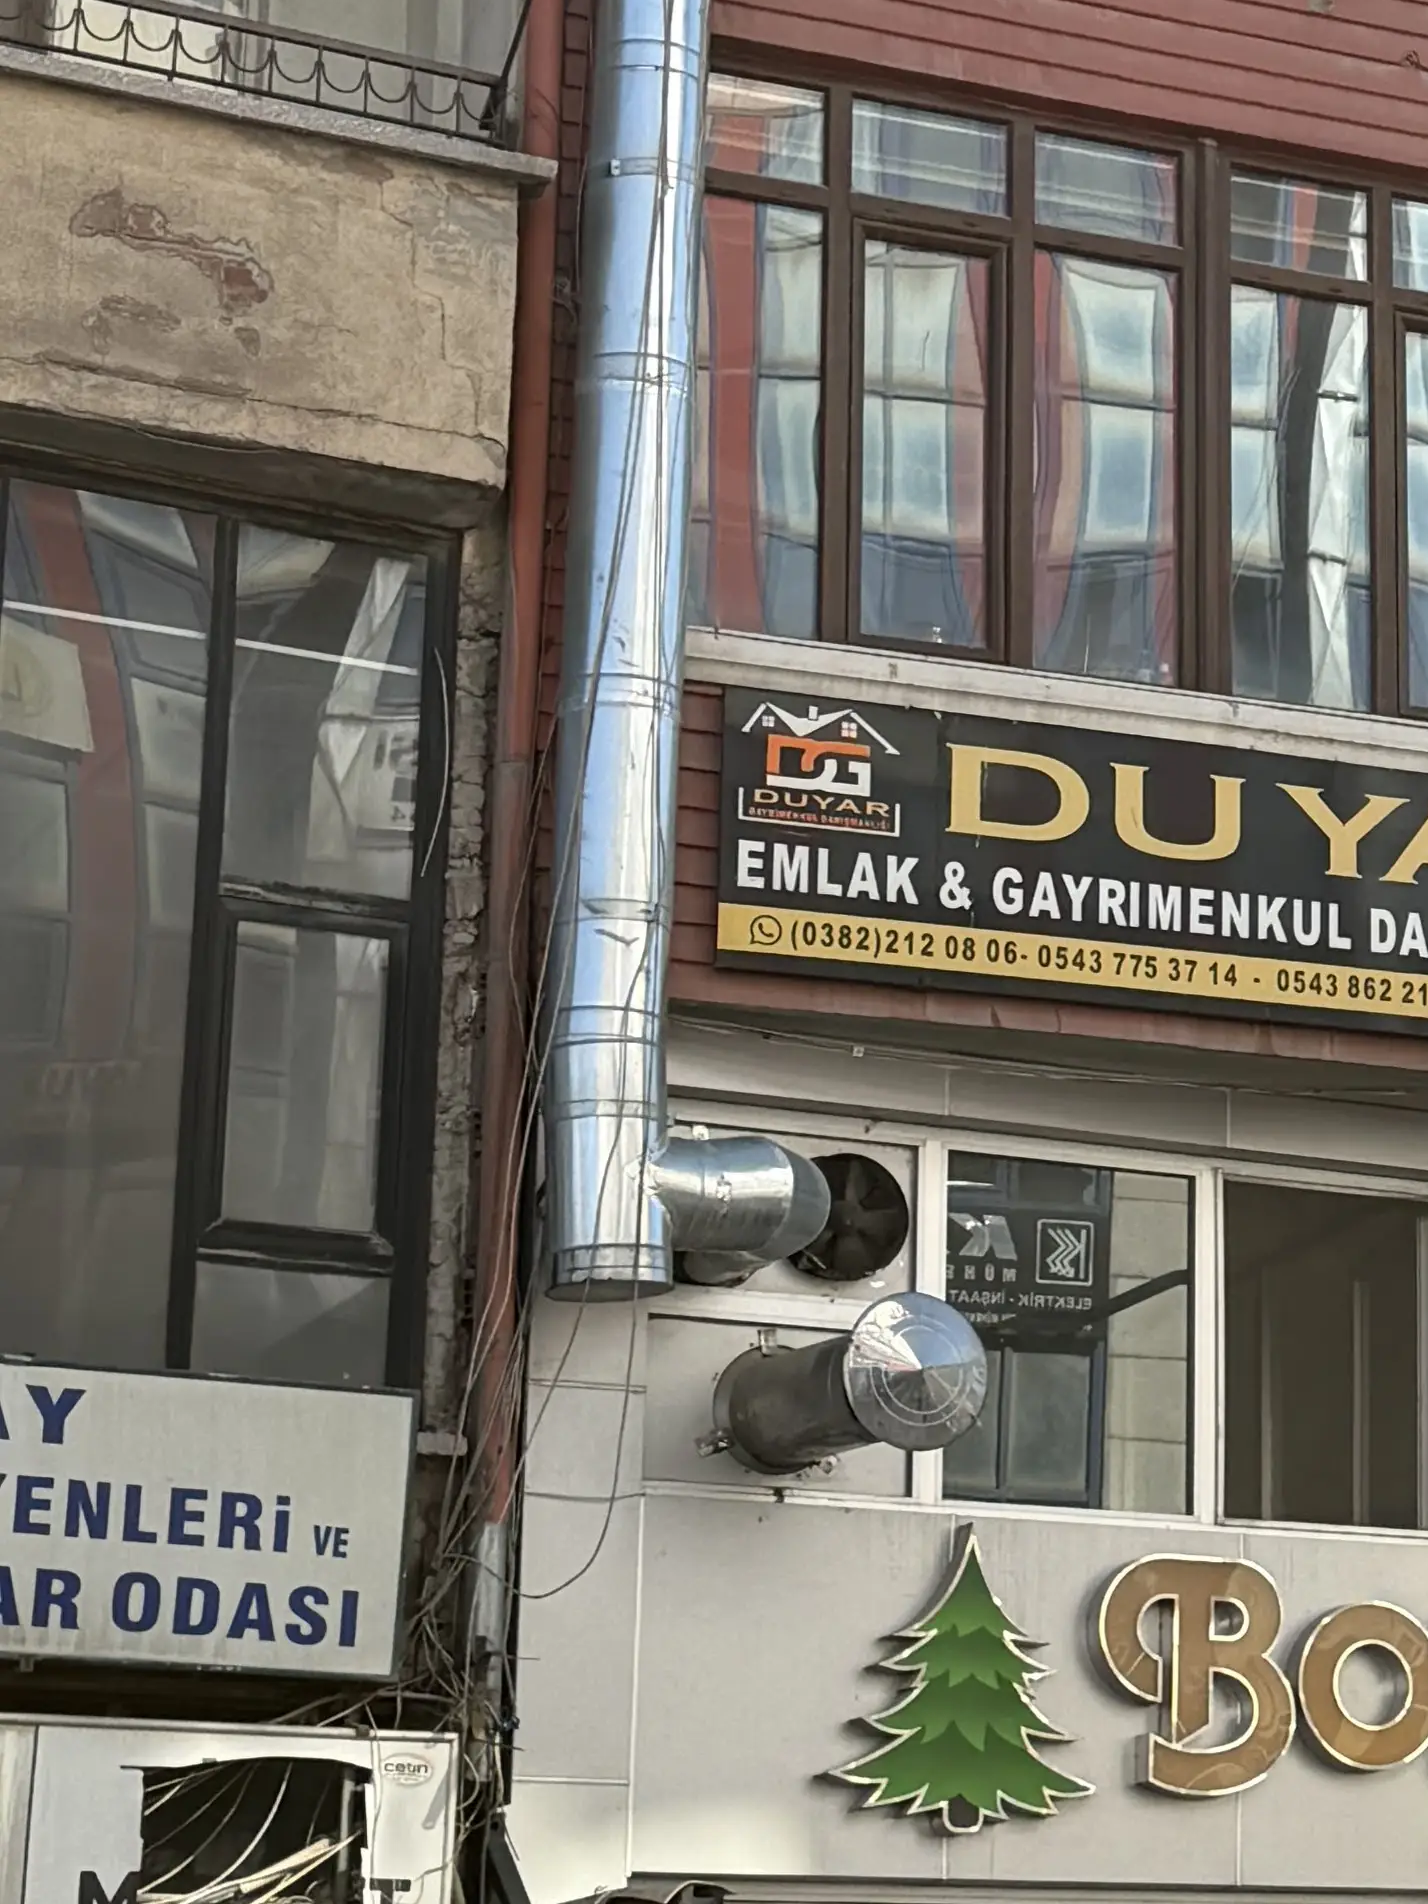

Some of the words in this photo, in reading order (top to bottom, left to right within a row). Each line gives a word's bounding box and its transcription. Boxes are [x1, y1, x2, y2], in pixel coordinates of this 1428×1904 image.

[754, 789, 890, 817] DUYAR
[737, 838, 920, 905] EMLAK
[938, 861, 972, 910] &
[992, 865, 1352, 950] GAYRIMENKUL
[1038, 948, 1101, 975] 0543
[1112, 952, 1158, 979] 775
[1168, 958, 1197, 983] 37
[1208, 961, 1238, 987] 14
[1276, 968, 1339, 997] 0543
[1347, 976, 1392, 1002] 862
[1400, 981, 1428, 1006] 21
[314, 1524, 350, 1559] VE
[111, 1570, 360, 1649] ODASI
